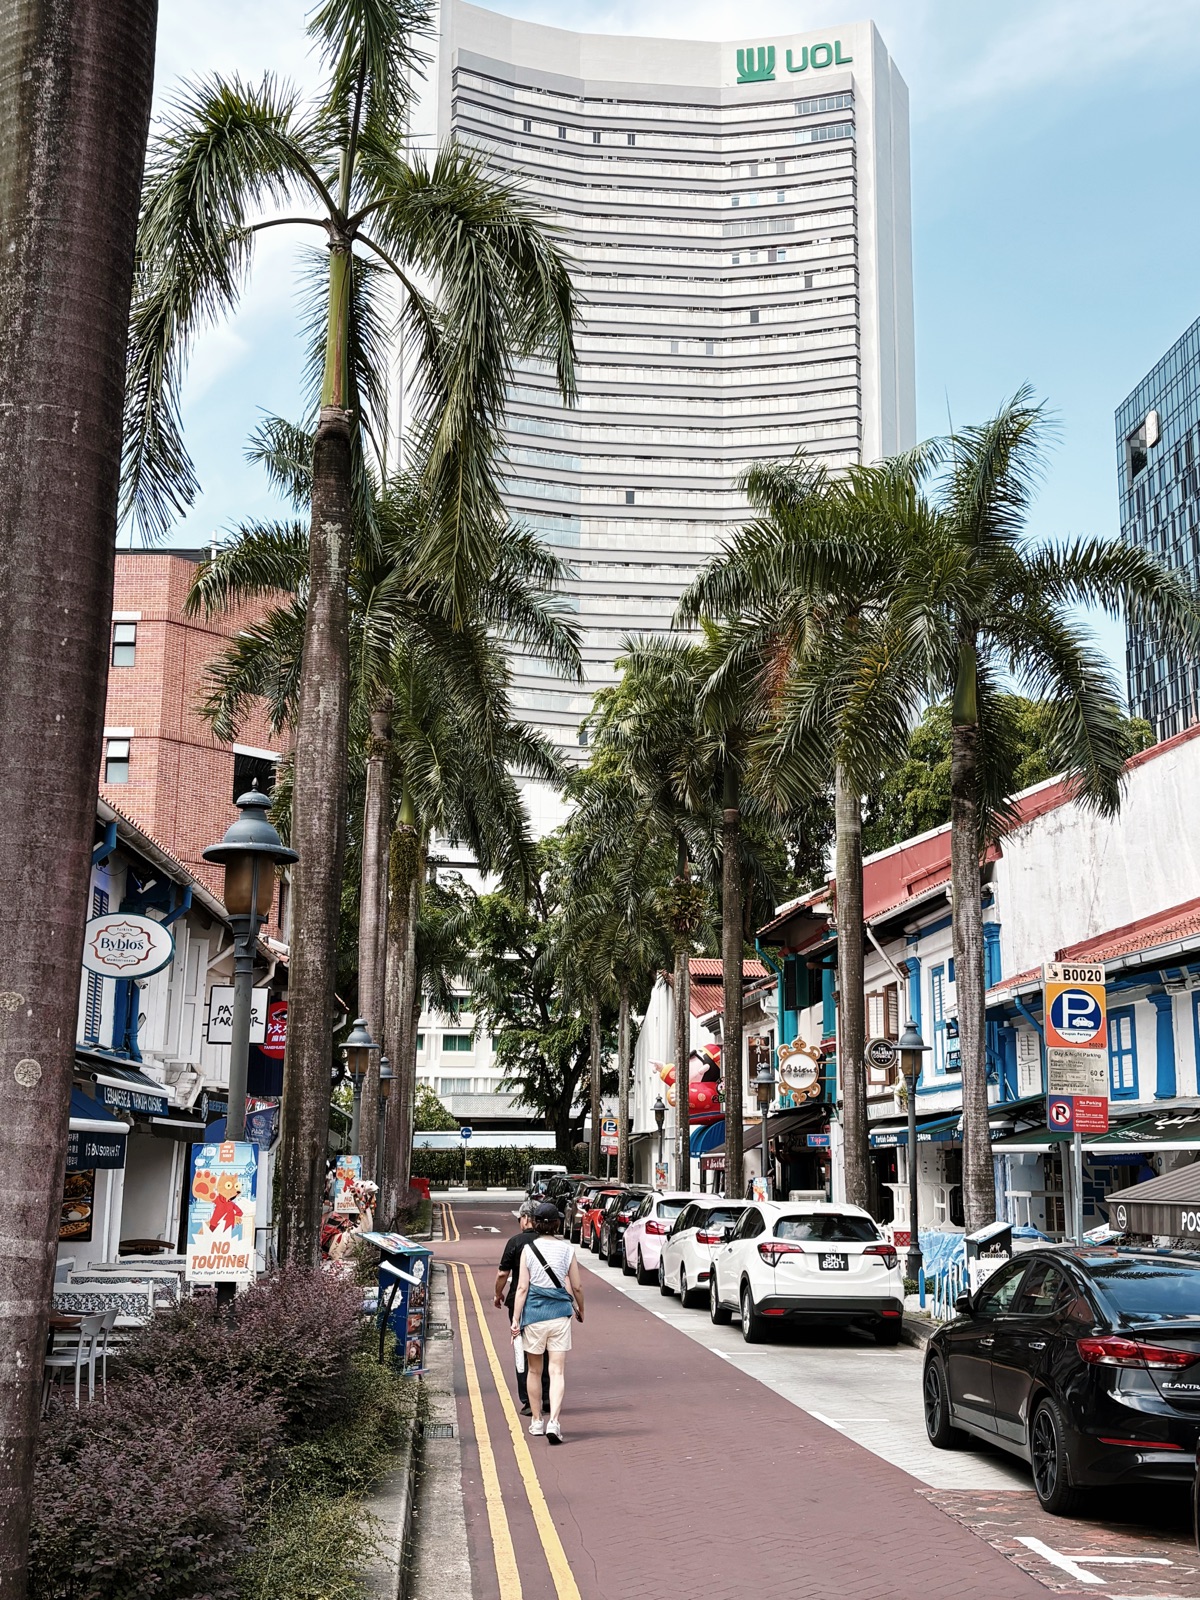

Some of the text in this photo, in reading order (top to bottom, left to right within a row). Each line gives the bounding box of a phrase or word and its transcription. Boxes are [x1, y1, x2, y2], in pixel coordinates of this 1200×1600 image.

[786, 40, 853, 73] UOL
[101, 937, 144, 952] Byblos
[1063, 969, 1102, 982] B0020
[104, 1087, 126, 1107] LEBANESE
[148, 1096, 163, 1113] CUISINE
[210, 1241, 231, 1255] NO
[192, 1254, 250, 1270] TOUTING!
[825, 1253, 842, 1261] SMJ
[822, 1261, 846, 1269] 820T
[1161, 1382, 1200, 1390] ELANTR
